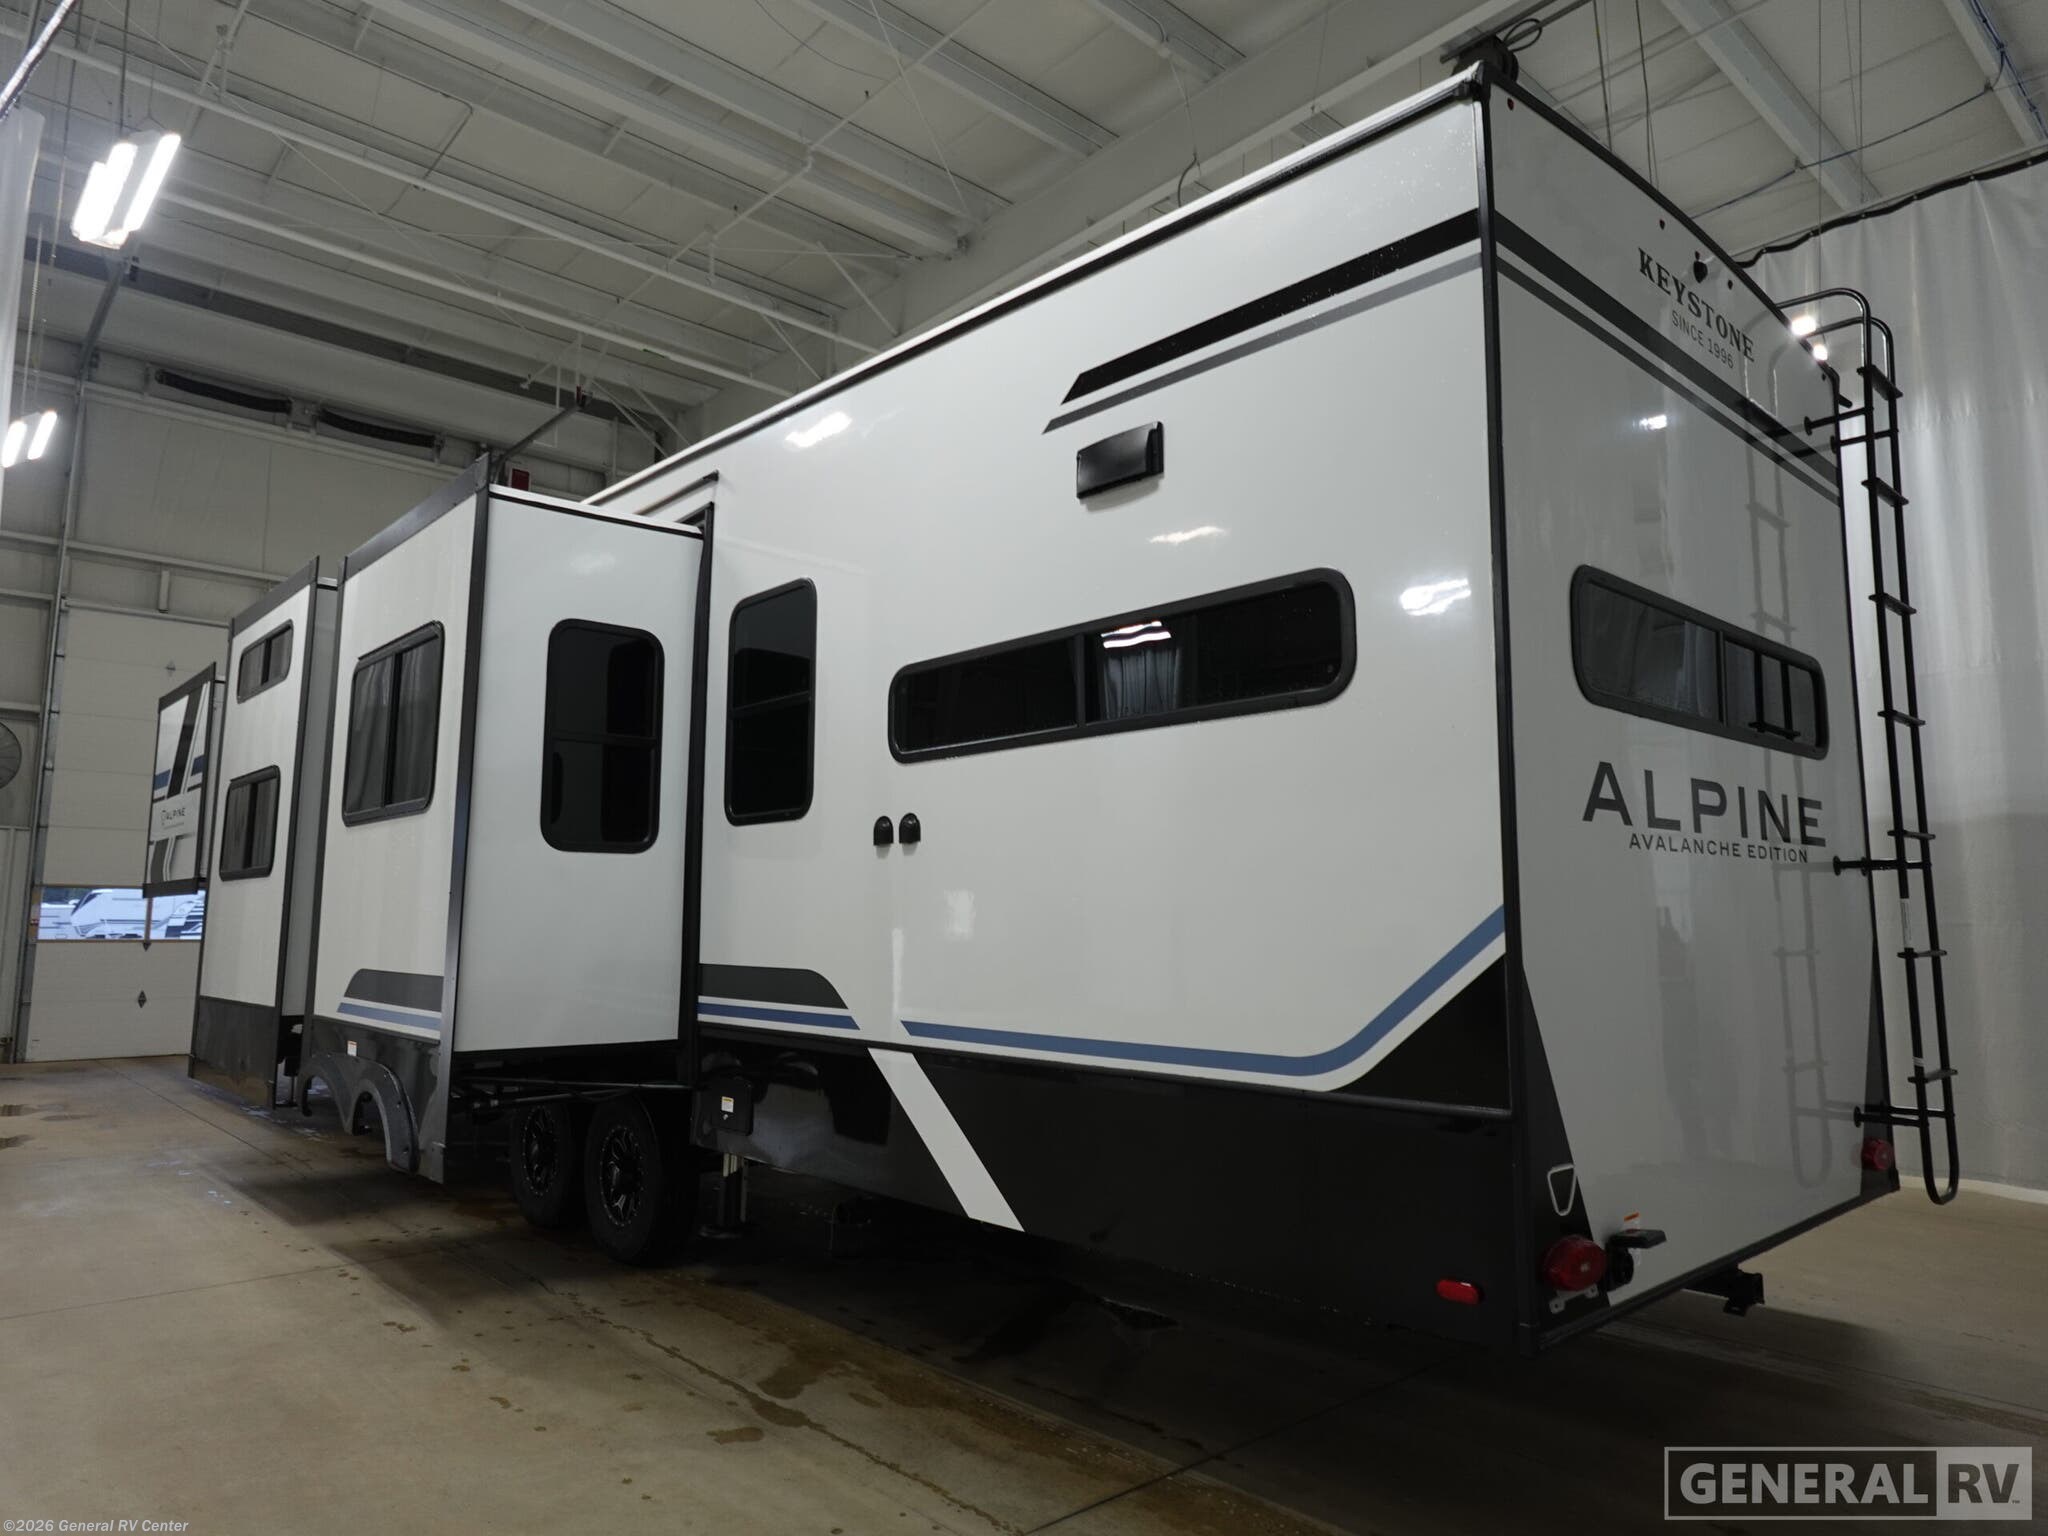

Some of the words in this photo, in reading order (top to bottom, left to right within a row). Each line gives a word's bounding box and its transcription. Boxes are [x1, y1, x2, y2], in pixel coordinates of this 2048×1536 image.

[1638, 247, 1755, 363] KEYSTONE
[1671, 309, 1704, 348] SINCE
[1707, 338, 1734, 369] 1996
[1582, 760, 1827, 848] ALPINE
[1629, 832, 1742, 858] AVALANCHE
[1747, 844, 1809, 864] EDITION
